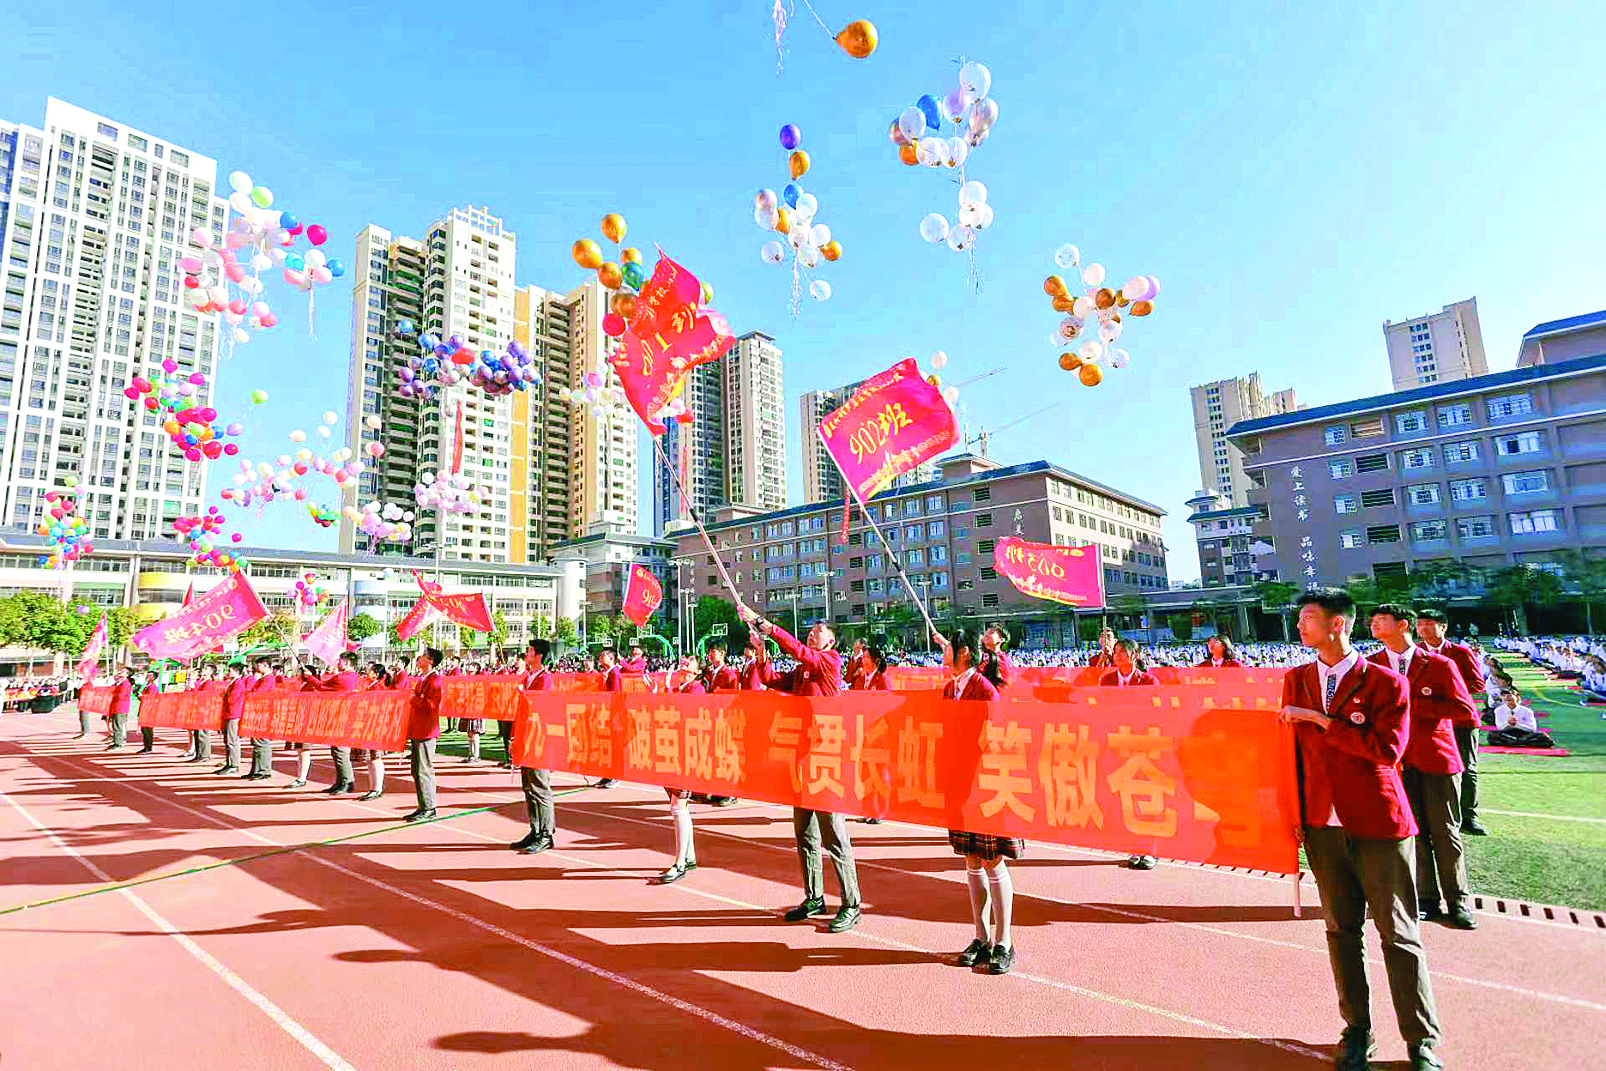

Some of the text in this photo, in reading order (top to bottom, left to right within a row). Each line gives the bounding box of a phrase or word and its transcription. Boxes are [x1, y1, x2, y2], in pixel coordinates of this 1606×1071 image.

[850, 403, 913, 465] 902班
[627, 704, 746, 784] 破茧成蝶
[768, 710, 945, 809] 气贯长虹
